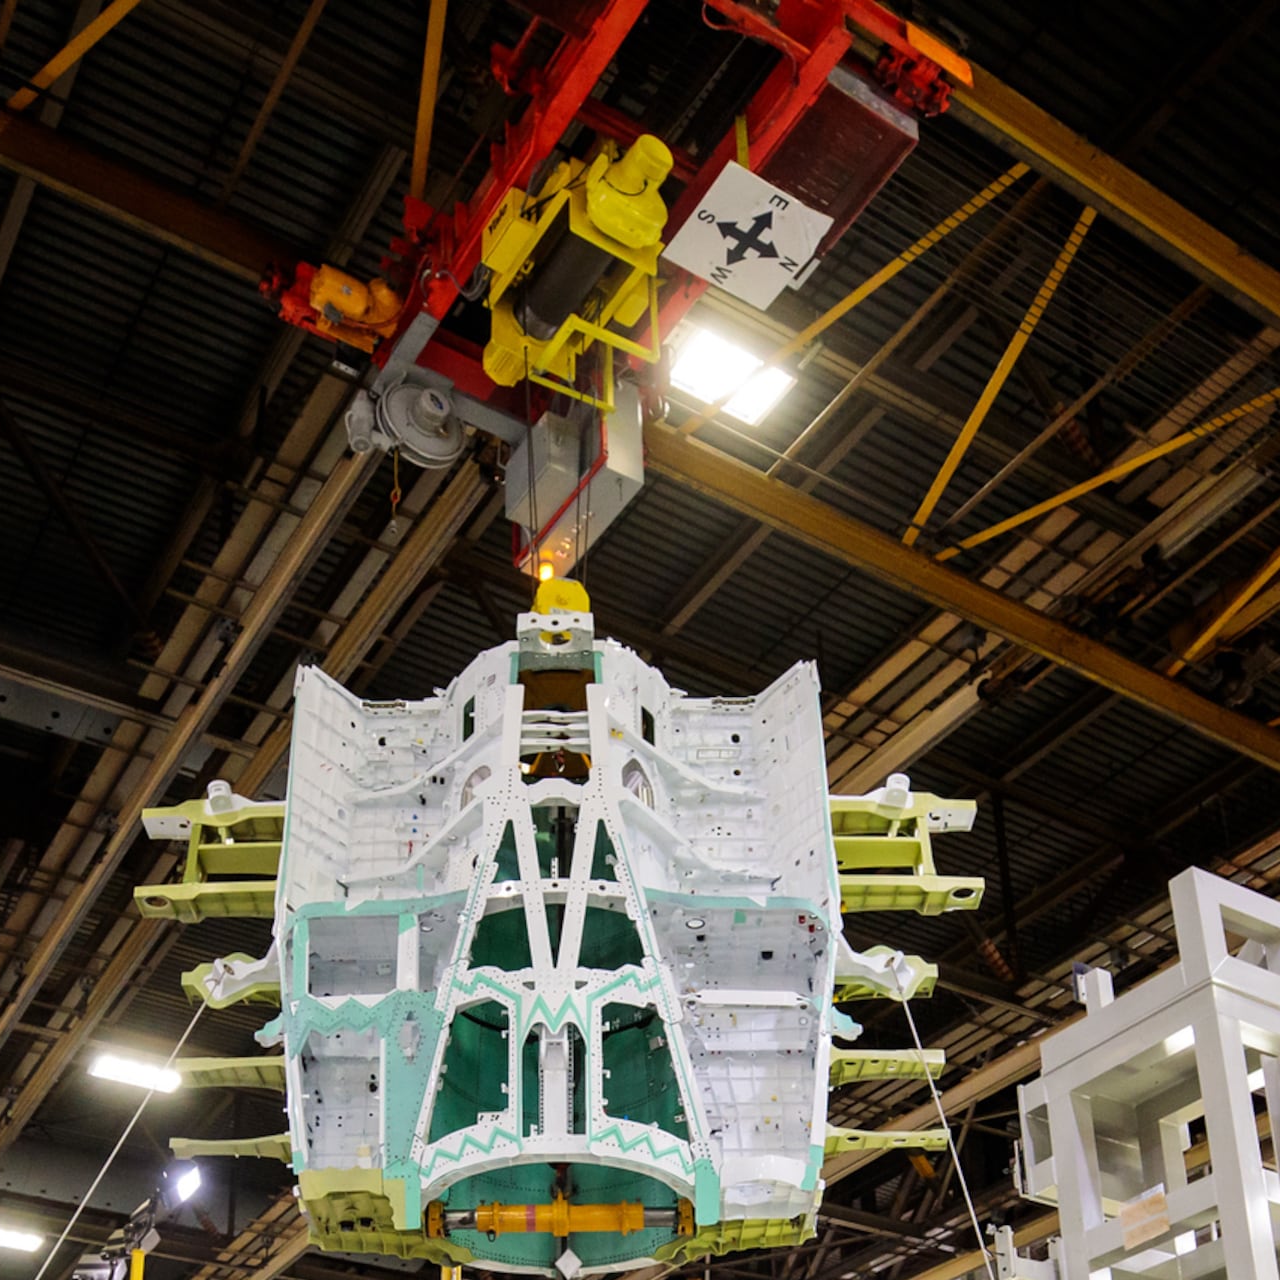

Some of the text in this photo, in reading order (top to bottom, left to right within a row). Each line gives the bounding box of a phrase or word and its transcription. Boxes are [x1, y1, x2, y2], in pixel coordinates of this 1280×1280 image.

[769, 194, 789, 211] E
[697, 209, 716, 225] S
[779, 256, 800, 273] N
[710, 266, 734, 285] W
